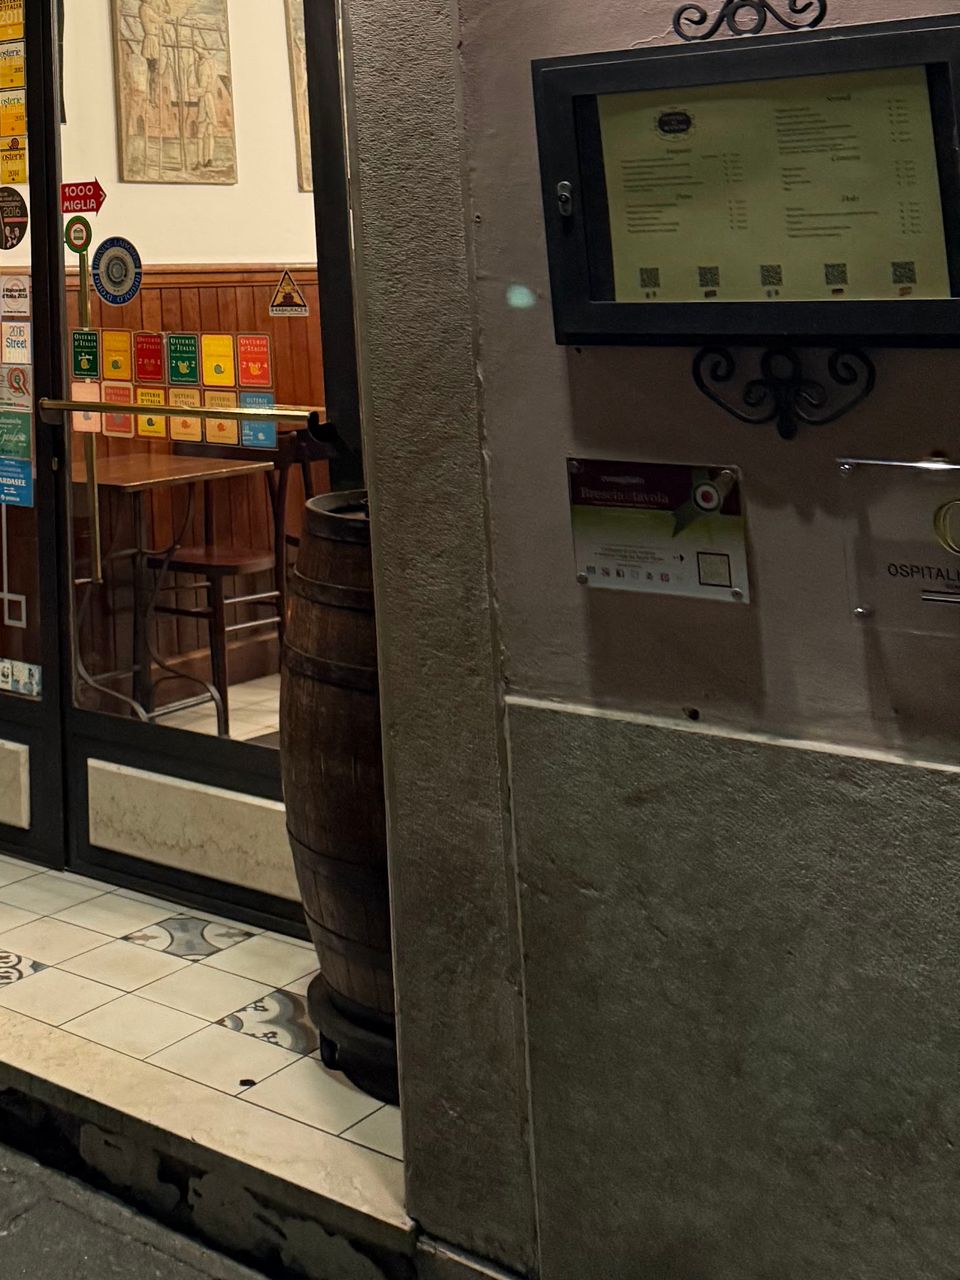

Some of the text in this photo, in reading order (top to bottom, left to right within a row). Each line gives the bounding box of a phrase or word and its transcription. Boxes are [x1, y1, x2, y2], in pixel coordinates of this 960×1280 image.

[64, 185, 94, 197] 1000
[63, 198, 97, 211] MIGLIA
[3, 207, 21, 217] 2016
[5, 337, 27, 349] Street
[170, 337, 195, 345] OSTERIE
